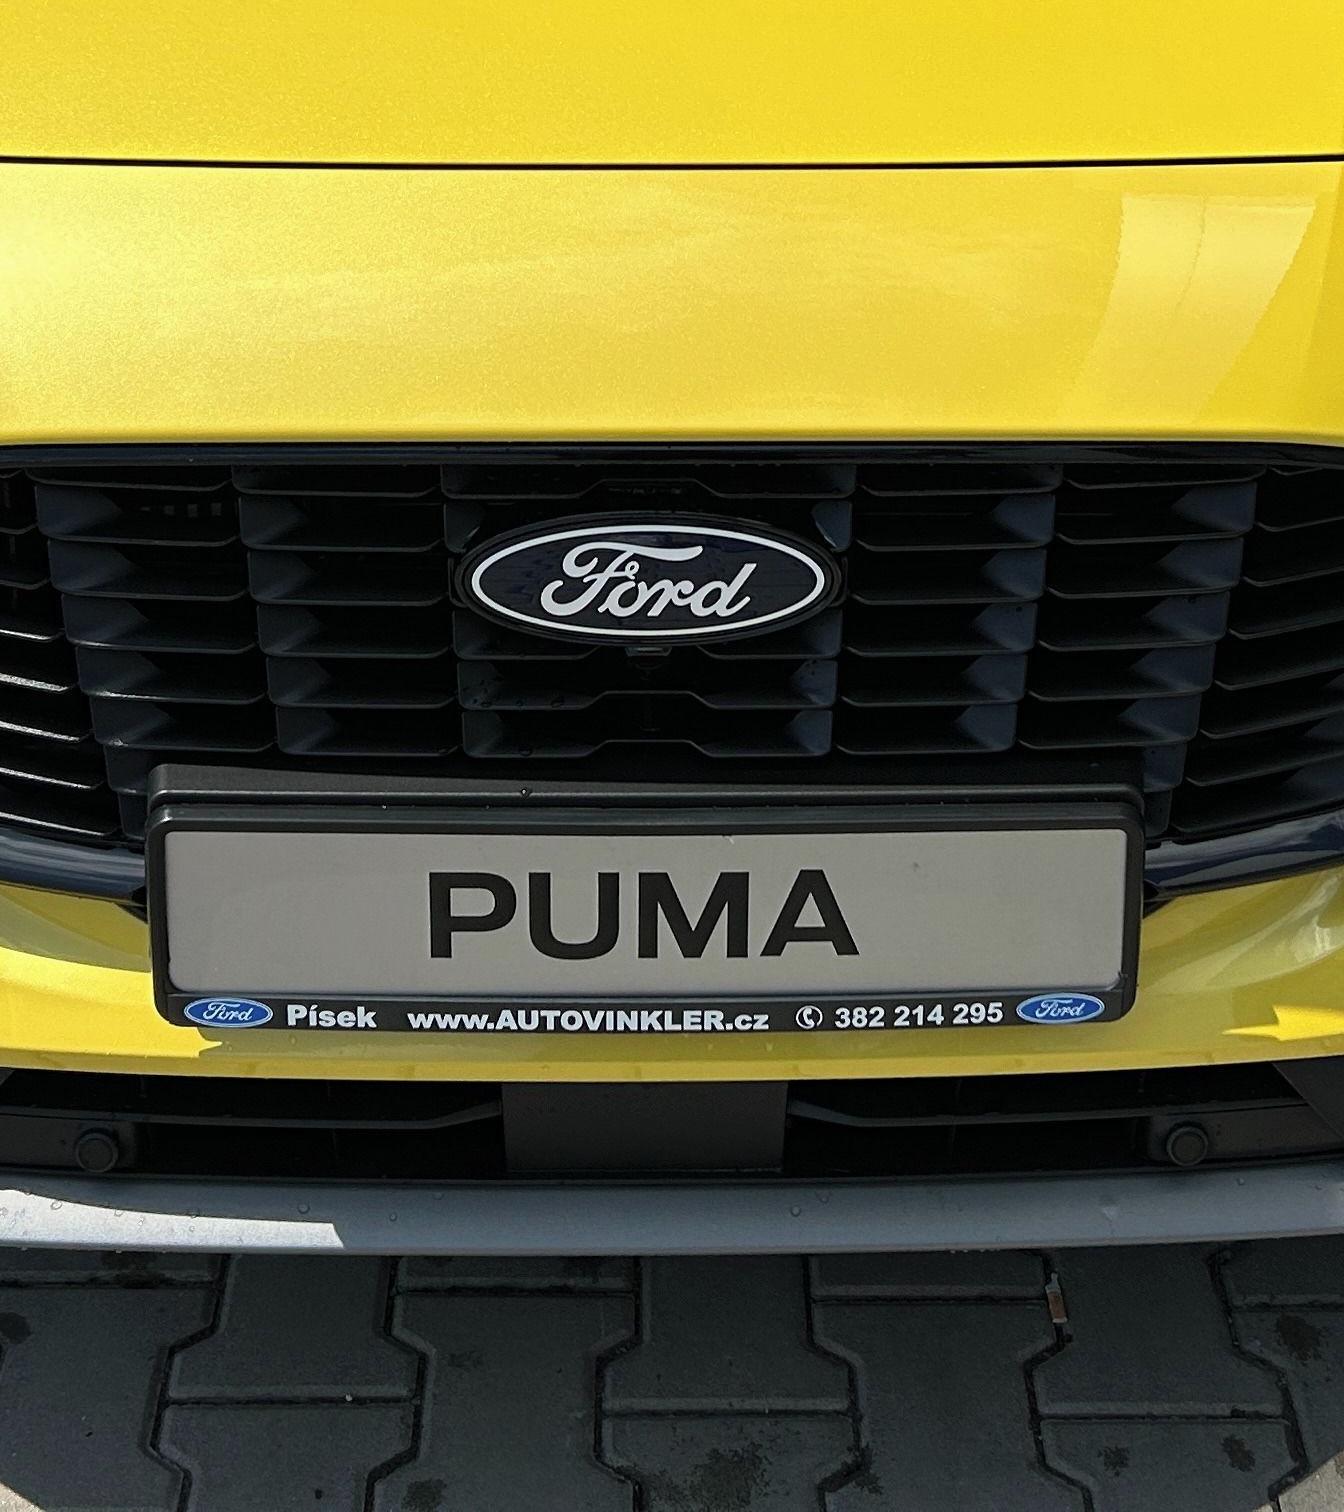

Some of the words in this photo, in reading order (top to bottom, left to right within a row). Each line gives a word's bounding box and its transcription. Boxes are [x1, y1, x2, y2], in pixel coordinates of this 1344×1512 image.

[540, 541, 757, 618] Ford
[428, 868, 861, 960] PUMA
[202, 1001, 253, 1022] Ford
[286, 1004, 378, 1029] Písek
[406, 1009, 770, 1031] www.AUTOVINKLER.cz
[834, 1005, 885, 1029] 382
[893, 1004, 945, 1027] 214
[952, 1002, 1004, 1024] 295
[1034, 998, 1086, 1018] Ford
